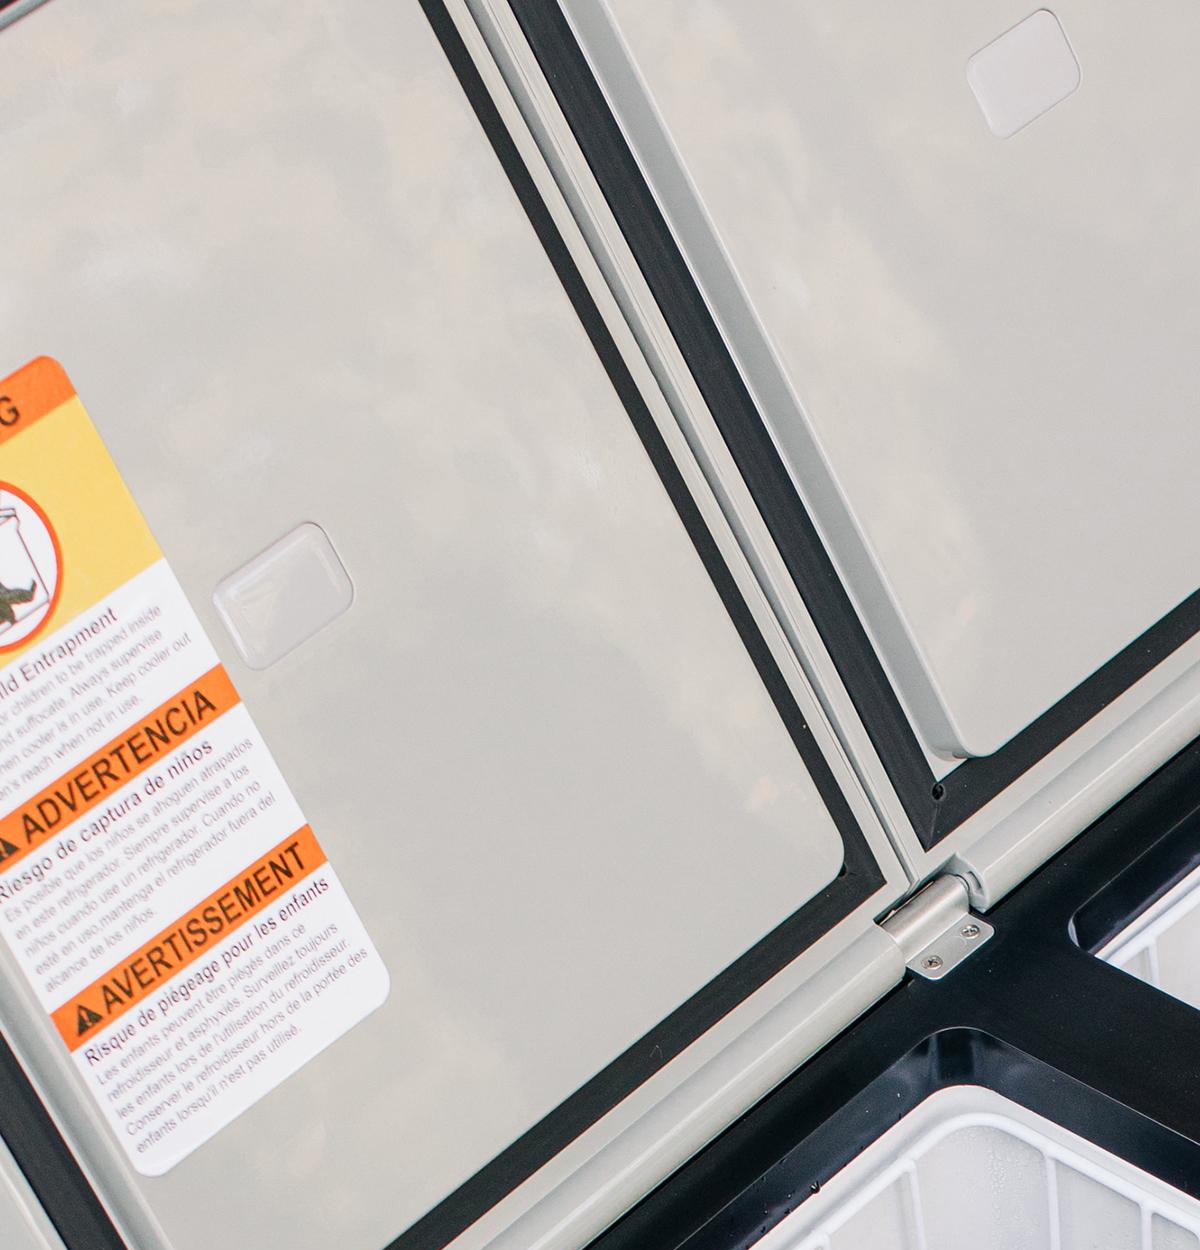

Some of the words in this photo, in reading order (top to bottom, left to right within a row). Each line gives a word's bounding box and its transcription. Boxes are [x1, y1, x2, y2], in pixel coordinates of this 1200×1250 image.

[10, 680, 56, 716] children
[54, 671, 69, 685] to
[66, 659, 85, 676] be
[83, 626, 129, 664] trapped
[127, 605, 161, 633] inside
[18, 607, 118, 682] Entrapment
[21, 728, 56, 758] cooler
[55, 720, 69, 733] is
[67, 711, 82, 725] in
[105, 672, 137, 698] Keep
[137, 646, 171, 676] cooler
[171, 631, 192, 652] out
[69, 667, 110, 699] Always
[109, 629, 162, 671] supervise
[20, 755, 54, 783] reach
[53, 733, 85, 759] when
[85, 717, 106, 737] not
[103, 710, 118, 723] in
[21, 689, 216, 844] ADVERTENCIA
[55, 839, 77, 860] de
[79, 792, 142, 842] captura
[143, 775, 164, 796] de
[167, 741, 213, 779] niños
[3, 906, 23, 923] Es
[21, 876, 63, 913] posible
[63, 859, 86, 881] que
[84, 846, 105, 863] los
[135, 812, 150, 828] se
[151, 777, 199, 817] ahoguen
[199, 738, 253, 782] atrapados
[15, 924, 32, 940] en
[31, 905, 57, 928] este
[122, 823, 170, 861] Siempre
[170, 784, 223, 827] supervise
[222, 777, 232, 789] a
[230, 765, 250, 782] los
[56, 899, 99, 935] cuando
[98, 883, 120, 904] use
[119, 871, 137, 888] un
[201, 792, 245, 827] Cuando
[244, 780, 261, 796] no
[60, 940, 77, 956] en
[154, 871, 167, 887] el
[165, 827, 227, 878] refrigerador
[227, 807, 258, 832] fuera
[257, 790, 276, 811] del
[44, 956, 88, 993] alcance
[88, 944, 105, 960] de
[103, 930, 124, 949] los
[83, 1023, 136, 1066] Risque
[137, 1008, 156, 1028] de
[157, 960, 220, 1017] piégeage
[220, 933, 253, 969] pour
[253, 917, 277, 939] les
[278, 878, 329, 922] enfants
[95, 1065, 120, 1086] Les
[119, 1034, 161, 1069] enfants
[160, 998, 206, 1040] peuvent
[263, 935, 292, 959] dans
[291, 923, 306, 939] ce
[101, 841, 304, 1014] AVERTISSEMENT
[106, 1047, 173, 1102] refroidisseur
[174, 1036, 188, 1051] et
[242, 955, 296, 998] Surveillez
[293, 923, 338, 960] toujours
[115, 1102, 135, 1120] les
[135, 1071, 176, 1106] enfants
[174, 1054, 198, 1074] lors
[197, 1042, 213, 1058] de
[268, 988, 285, 1004] du
[125, 1090, 182, 1136] Conserver
[181, 1080, 195, 1094] le
[195, 1029, 260, 1084] refroidisseur
[259, 1011, 286, 1034] hors
[286, 999, 301, 1015] de
[299, 990, 313, 1003] la
[347, 948, 368, 968] des
[136, 1118, 177, 1153] enfants
[245, 1049, 267, 1072] pas
